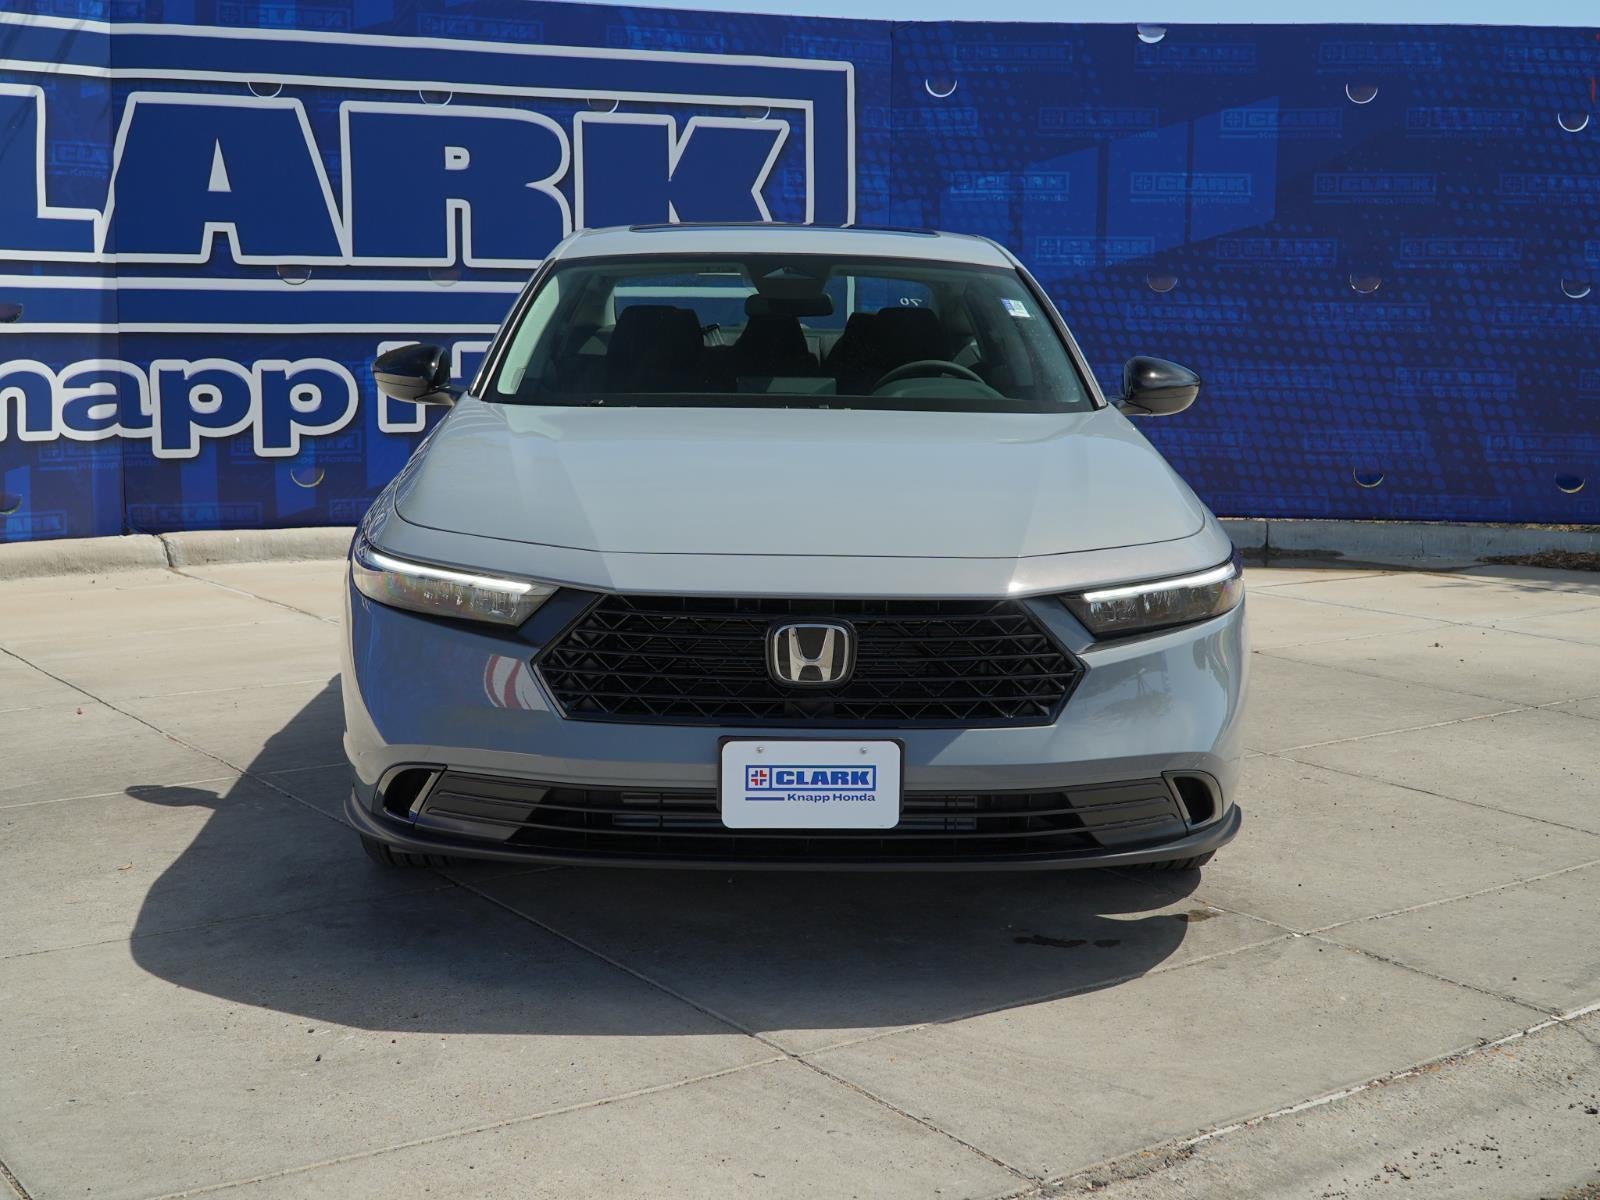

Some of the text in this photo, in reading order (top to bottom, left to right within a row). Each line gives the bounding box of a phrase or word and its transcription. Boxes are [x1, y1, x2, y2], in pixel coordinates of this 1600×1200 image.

[775, 770, 871, 786] CLARK
[787, 793, 876, 804] Knapp Honda
